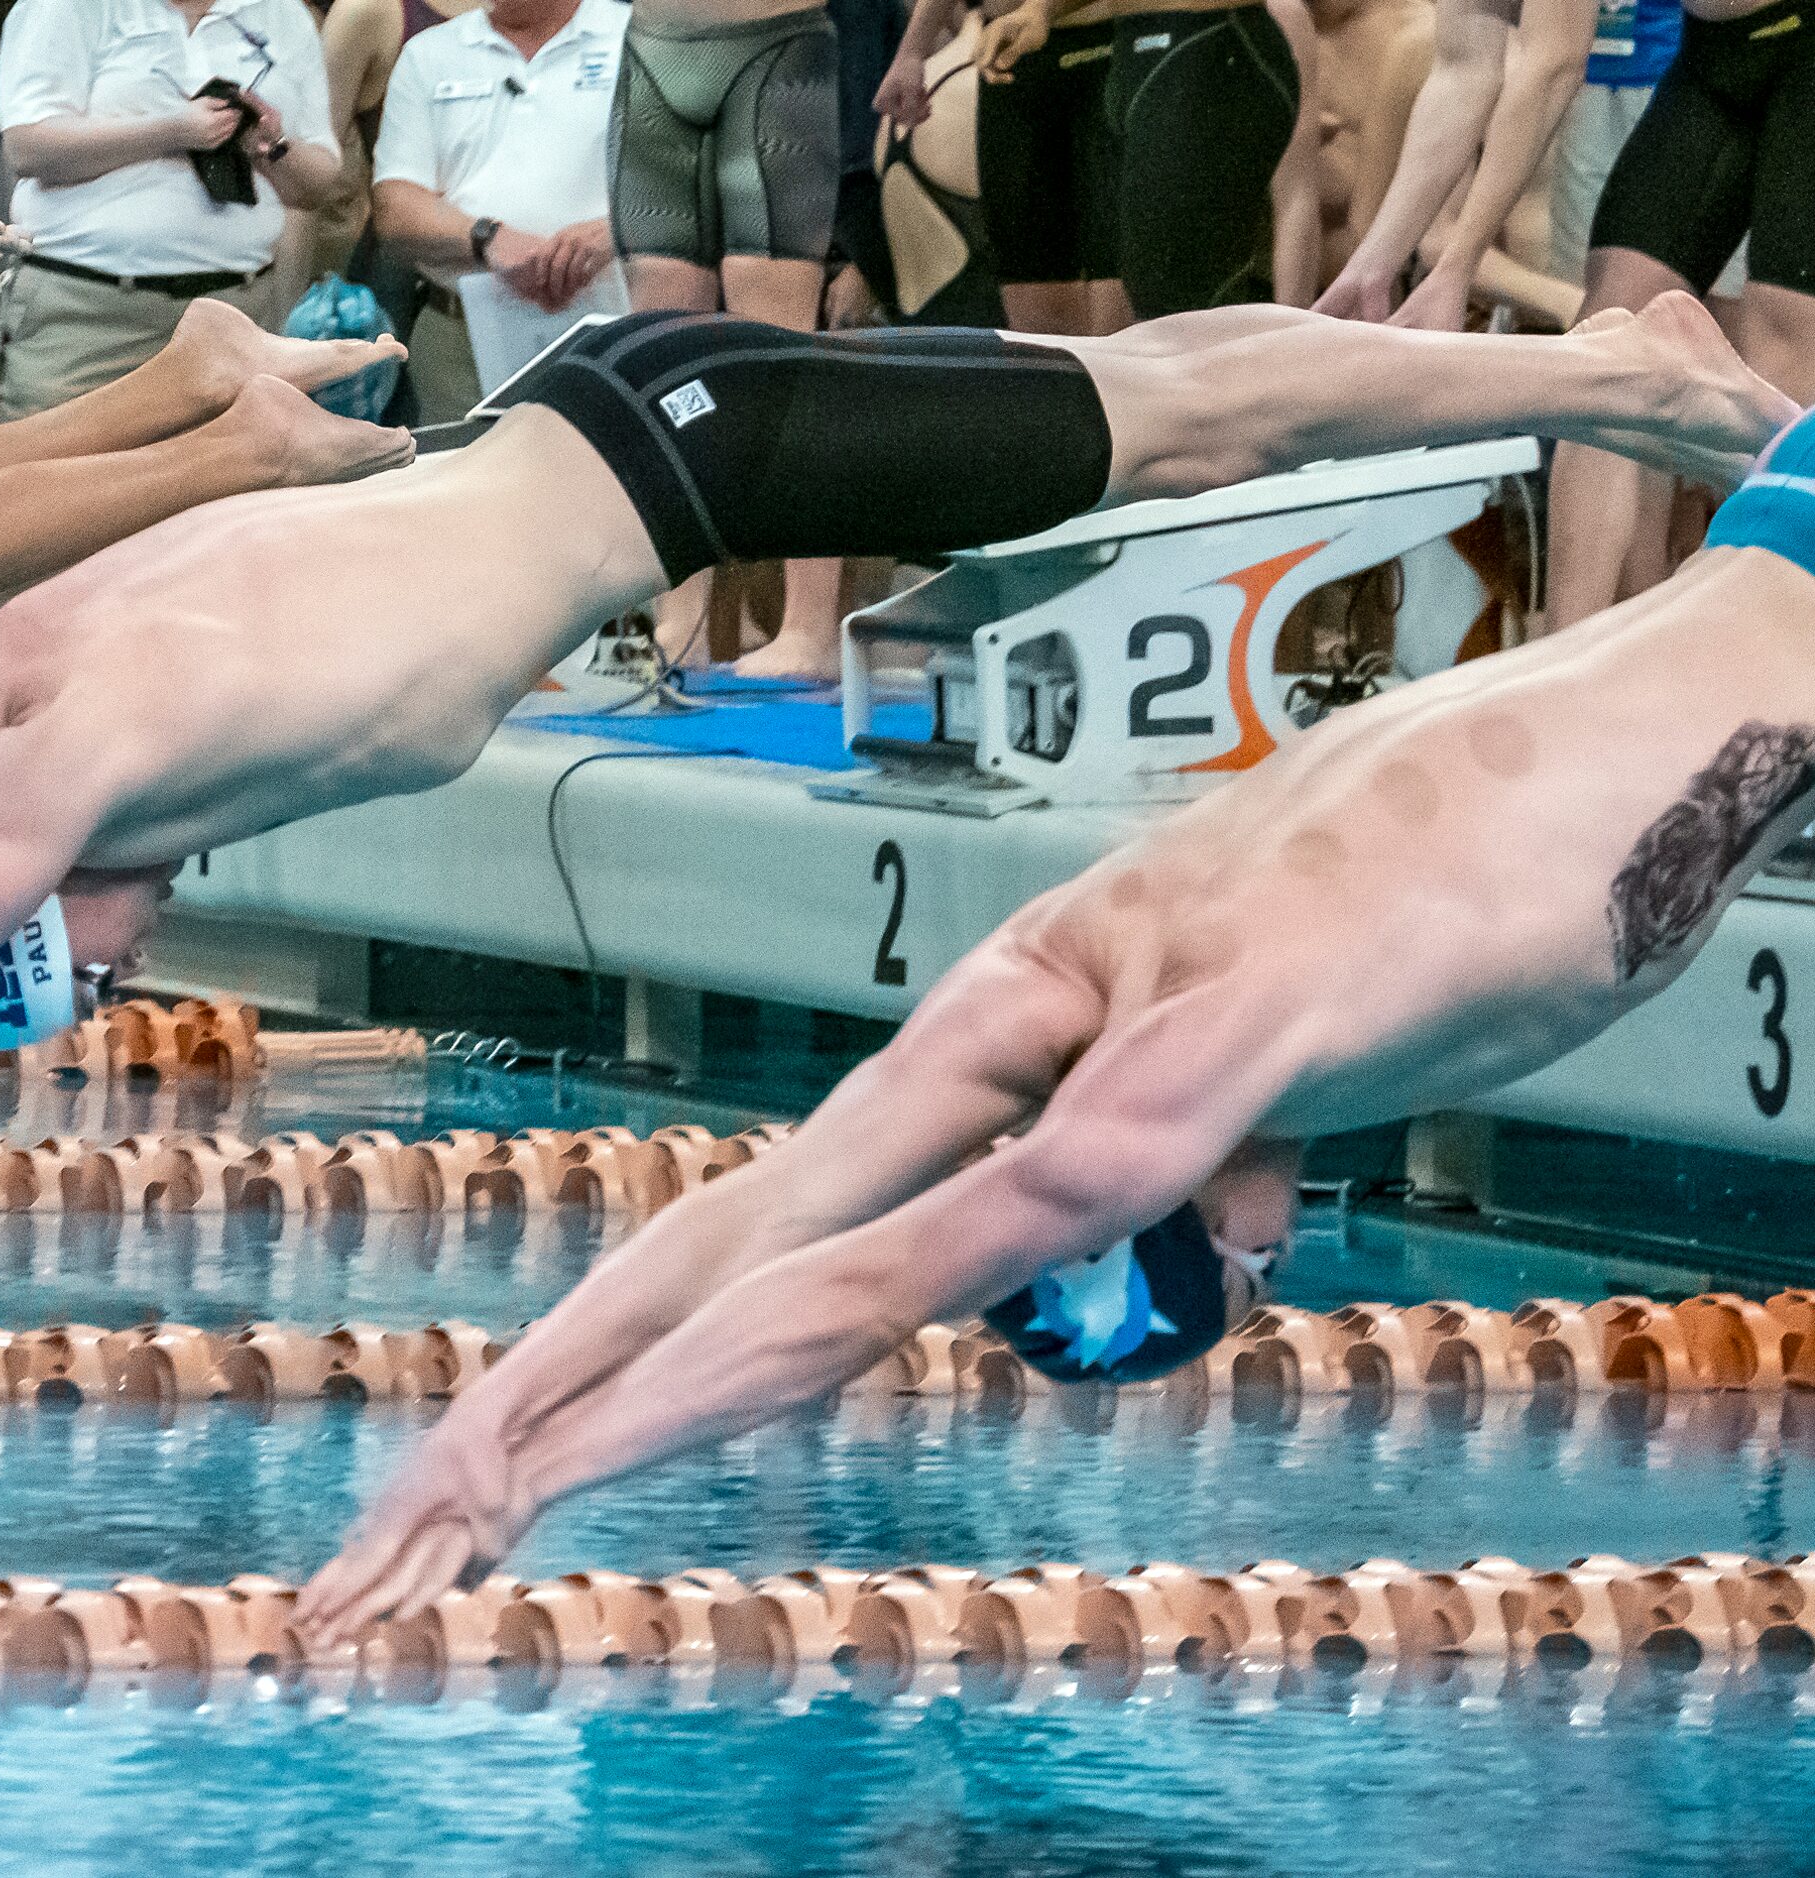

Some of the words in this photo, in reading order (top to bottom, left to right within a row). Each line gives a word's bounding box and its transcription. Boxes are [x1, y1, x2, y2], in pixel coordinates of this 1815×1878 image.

[1128, 614, 1213, 737] 2
[874, 839, 907, 986] 2
[1746, 948, 1792, 1118] 3
